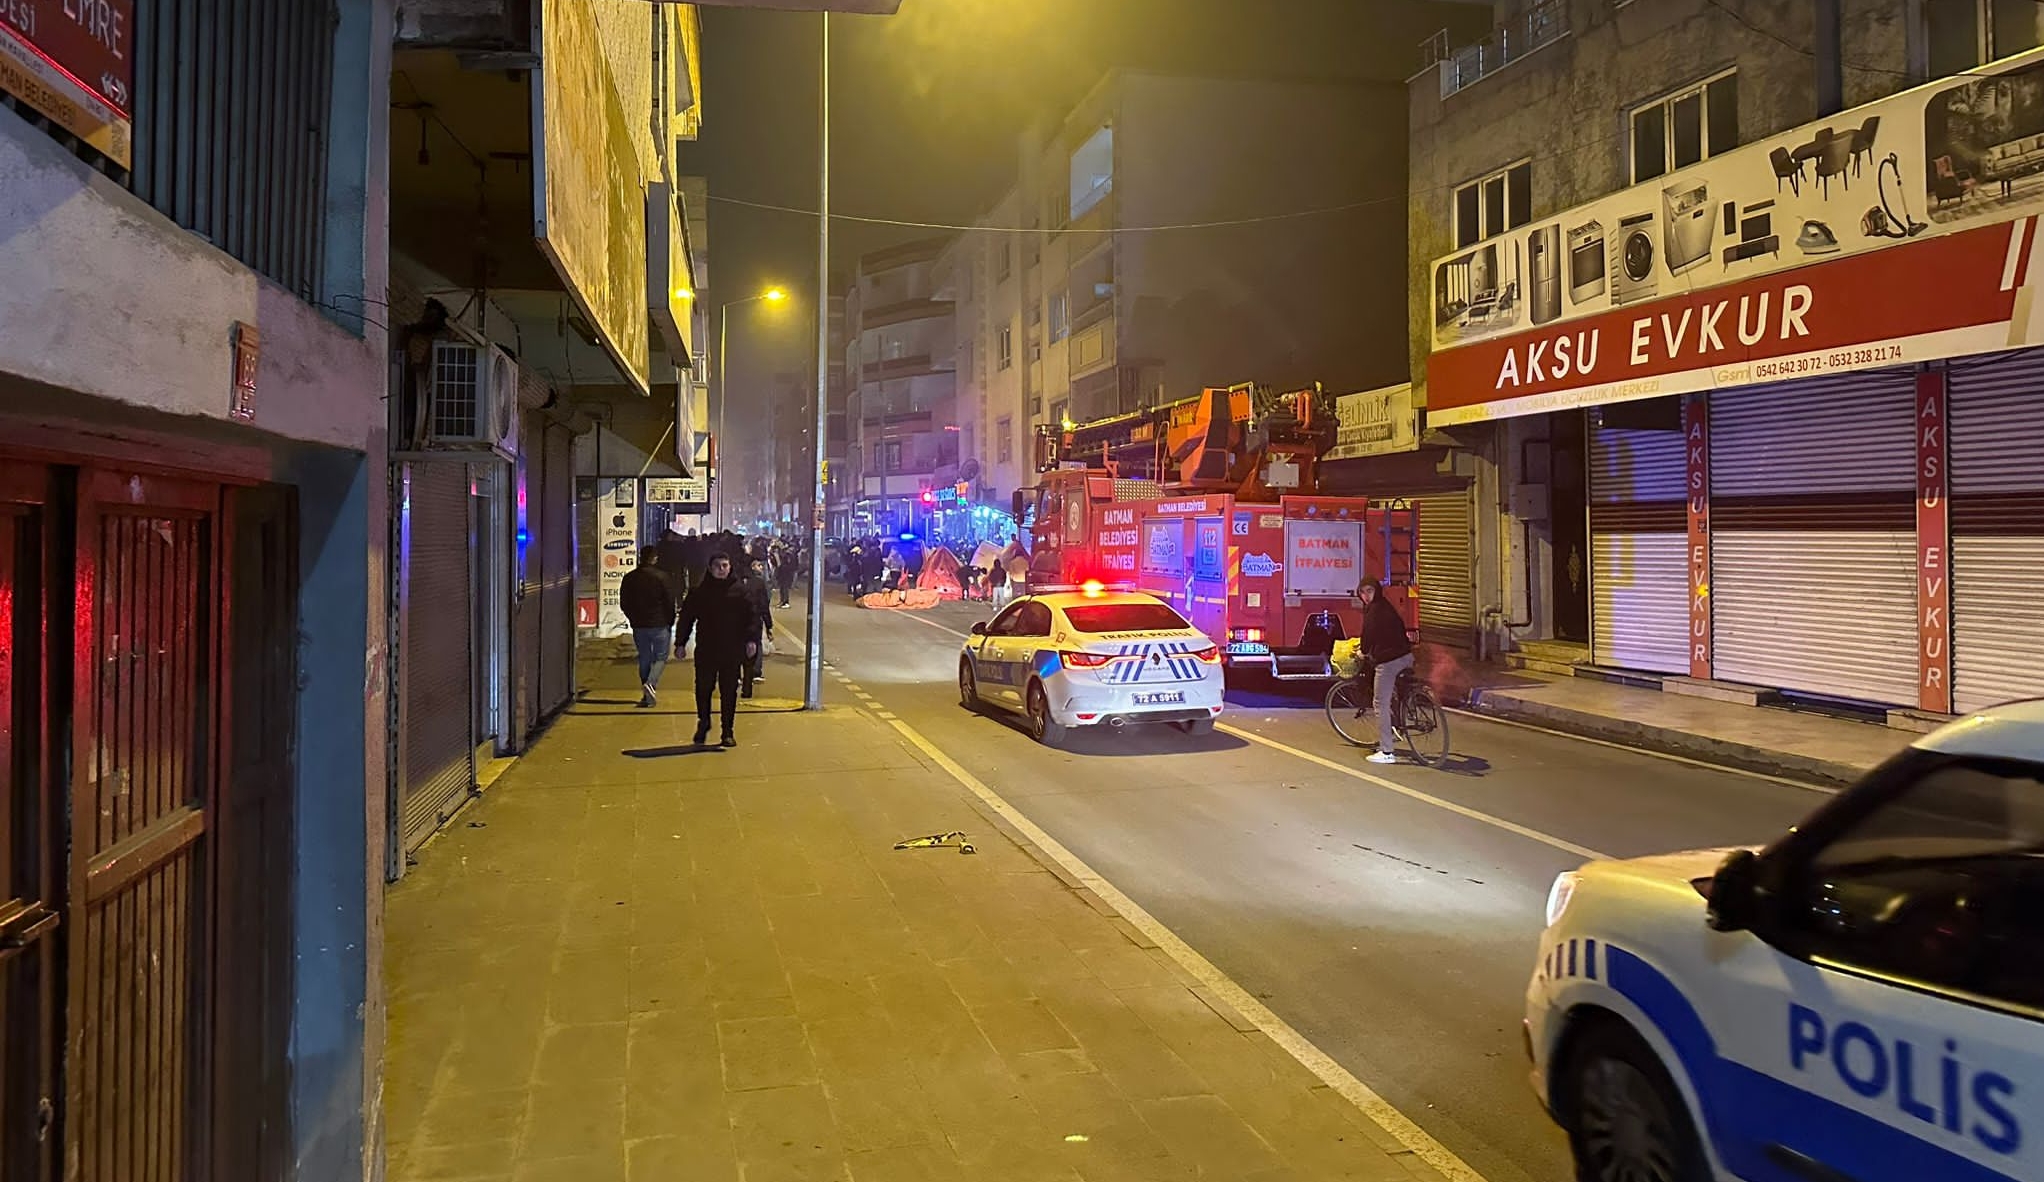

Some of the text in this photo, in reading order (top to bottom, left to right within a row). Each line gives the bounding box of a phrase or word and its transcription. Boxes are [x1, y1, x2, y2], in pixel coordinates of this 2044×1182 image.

[1496, 284, 1814, 389] AKSU EVKUR
[1717, 368, 1750, 383] Gsm
[1756, 363, 1777, 378] 0542
[1779, 361, 1795, 374] 642
[1798, 359, 1808, 372] 30
[1810, 357, 1821, 370] 72
[1829, 353, 1852, 367] 0532
[1854, 349, 1873, 364] 328
[1875, 348, 1886, 361] 21
[1889, 345, 1901, 358] 74
[1104, 509, 1133, 526] BATMAN
[606, 528, 632, 537] iPhone
[1099, 525, 1139, 547] BELEDİYESİ
[1204, 529, 1217, 546] 112
[1234, 523, 1247, 533] CE
[1298, 538, 1350, 549] BATMAN
[1690, 421, 1706, 662] AKSU EVKUR
[1921, 396, 1942, 689] AKSU EVKUR
[1138, 695, 1149, 703] 72
[1151, 694, 1158, 702] A
[1788, 1001, 2022, 1155] POLİS
